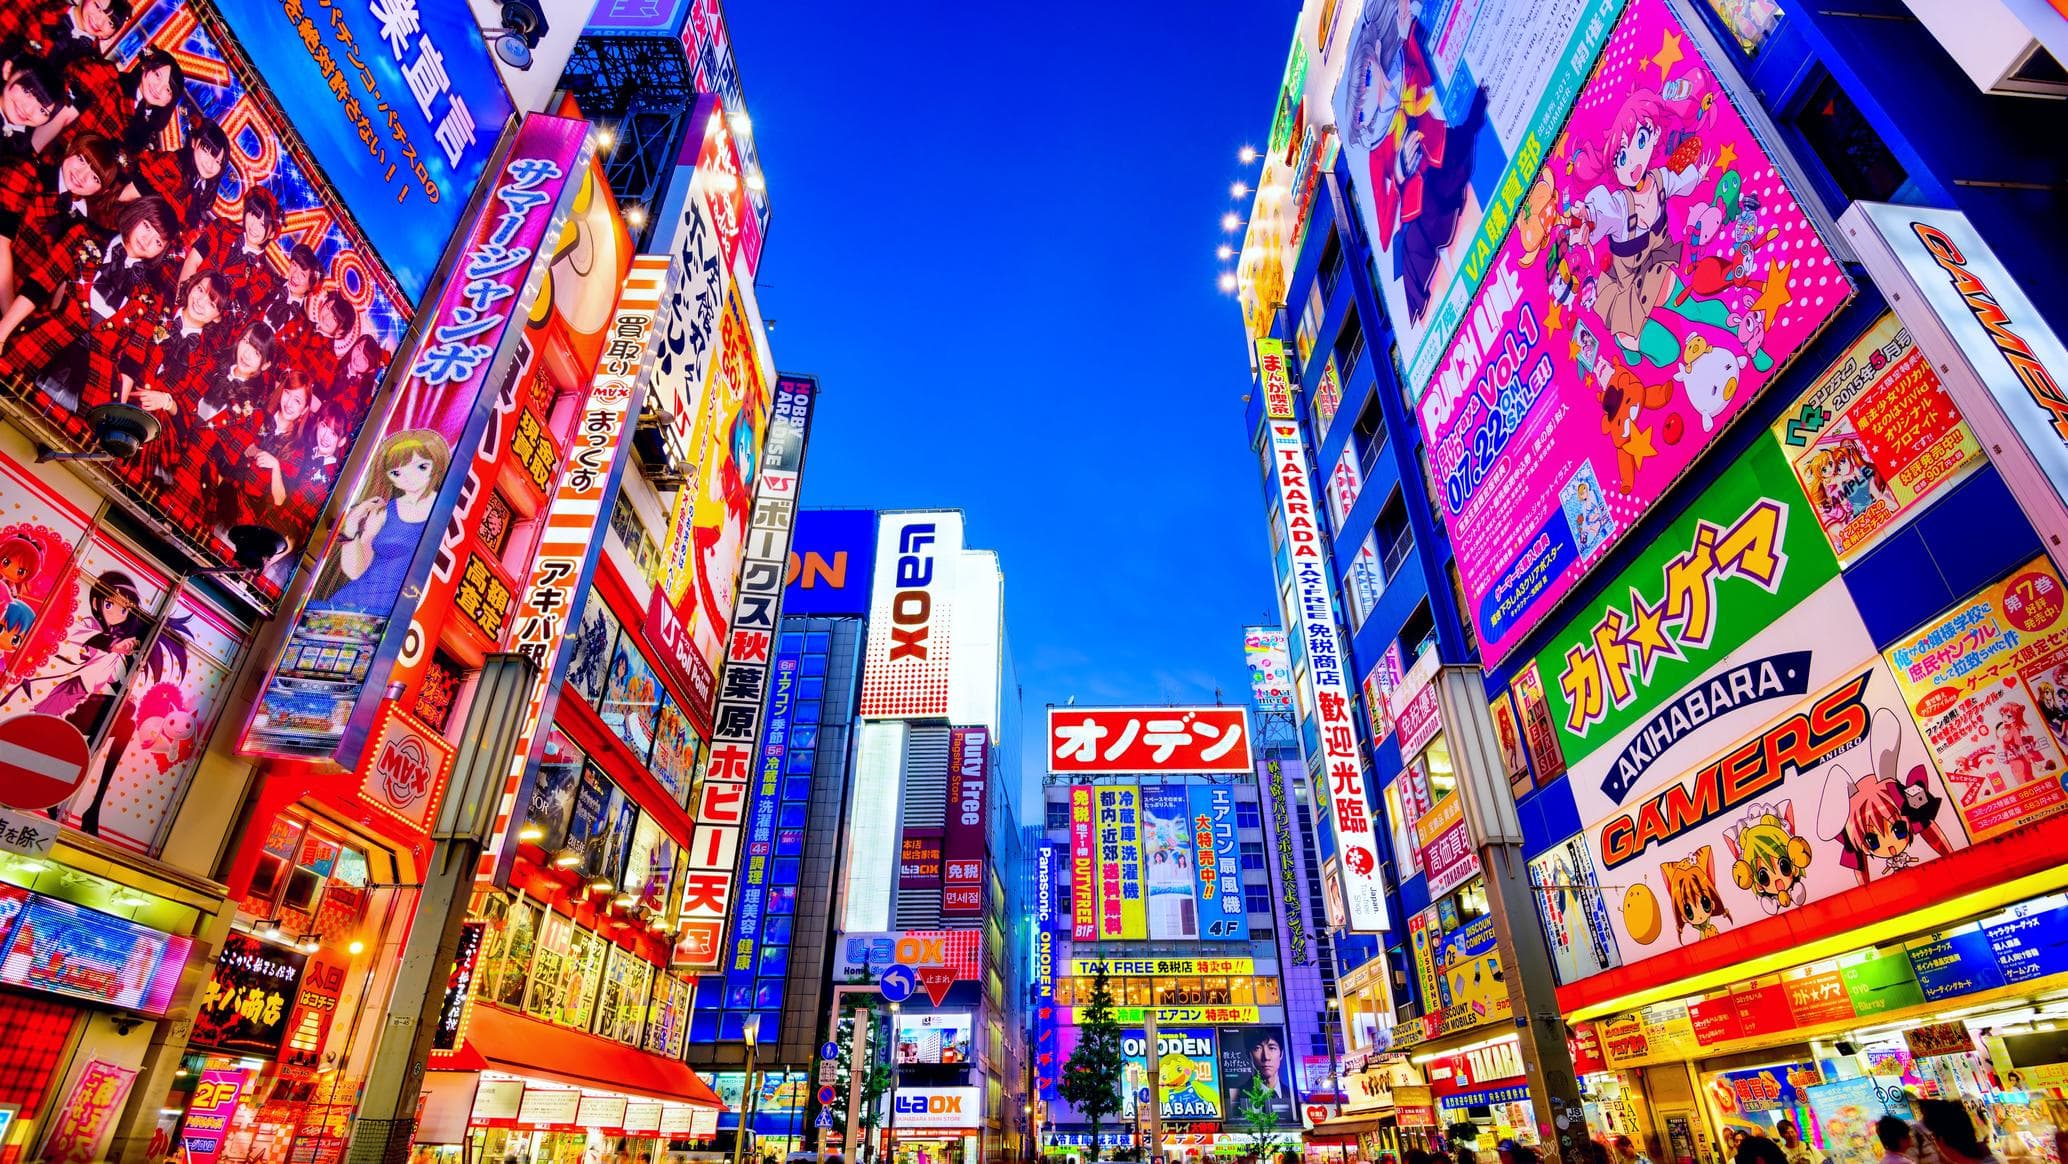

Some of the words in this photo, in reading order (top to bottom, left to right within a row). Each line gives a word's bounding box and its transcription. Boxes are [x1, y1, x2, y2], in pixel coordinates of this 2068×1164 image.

[411, 157, 563, 387] サマージャンボ
[605, 315, 650, 378] 買取り
[1421, 335, 1484, 443] PUNCH
[1482, 260, 1523, 357] LINE
[1831, 328, 1913, 411] 2015年5月号
[788, 382, 810, 436] HOBBY
[1262, 353, 1292, 417] まんが喫茶
[1501, 382, 1523, 412] ON
[1857, 362, 1930, 432] 魔法少女リリカル
[766, 381, 793, 465] PARADISE
[1884, 398, 1932, 443] オリジナル
[571, 410, 627, 494] まっくす
[1446, 416, 1513, 515] 07.22
[1278, 449, 1318, 558] TAKARADA
[1822, 466, 1877, 514] SAMPLE
[2003, 575, 2054, 614] 第7巻
[2022, 604, 2060, 631] 発売中!
[2024, 597, 2049, 616] 好評
[1308, 622, 1341, 686] 免税商店
[1055, 711, 1242, 763] オノデン
[1618, 658, 1785, 788] AKIHABARA
[960, 732, 986, 777] Duty
[1317, 690, 1369, 834] 歓迎光臨
[1600, 668, 1875, 871] GAMERS
[1819, 736, 1863, 765] ANIBRO
[753, 756, 781, 842] 冷蔵庫・洗濯機
[961, 781, 984, 826] Free
[1073, 789, 1090, 823] 免税
[1119, 790, 1137, 842] 冷蔵庫
[1212, 789, 1234, 855] エアコン
[948, 864, 979, 879] 免税
[1121, 845, 1139, 900] 洗濯機
[1194, 814, 1217, 900] 大特売中!!
[946, 891, 979, 904] 면세점
[1039, 847, 1052, 922] Panasonic
[1218, 856, 1242, 915] 扇風機
[1075, 925, 1095, 938] B1F
[1208, 920, 1239, 936] 4F
[1411, 915, 1424, 932] 2F
[306, 960, 345, 993] 入口
[926, 974, 951, 985] 止まれ
[1039, 932, 1052, 998] ONODEN
[1079, 961, 1110, 974] TAX
[1114, 961, 1154, 974] FREE
[1157, 960, 1193, 973] 免税店
[1852, 984, 1870, 995] DVD
[300, 990, 336, 1012] はコチラ
[1157, 1010, 1201, 1022] エアコン
[1204, 1008, 1253, 1023] 特売中!!
[1450, 1014, 1477, 1031] MOBILES
[194, 1083, 238, 1109] 2F
[1568, 1107, 1581, 1116] JS
